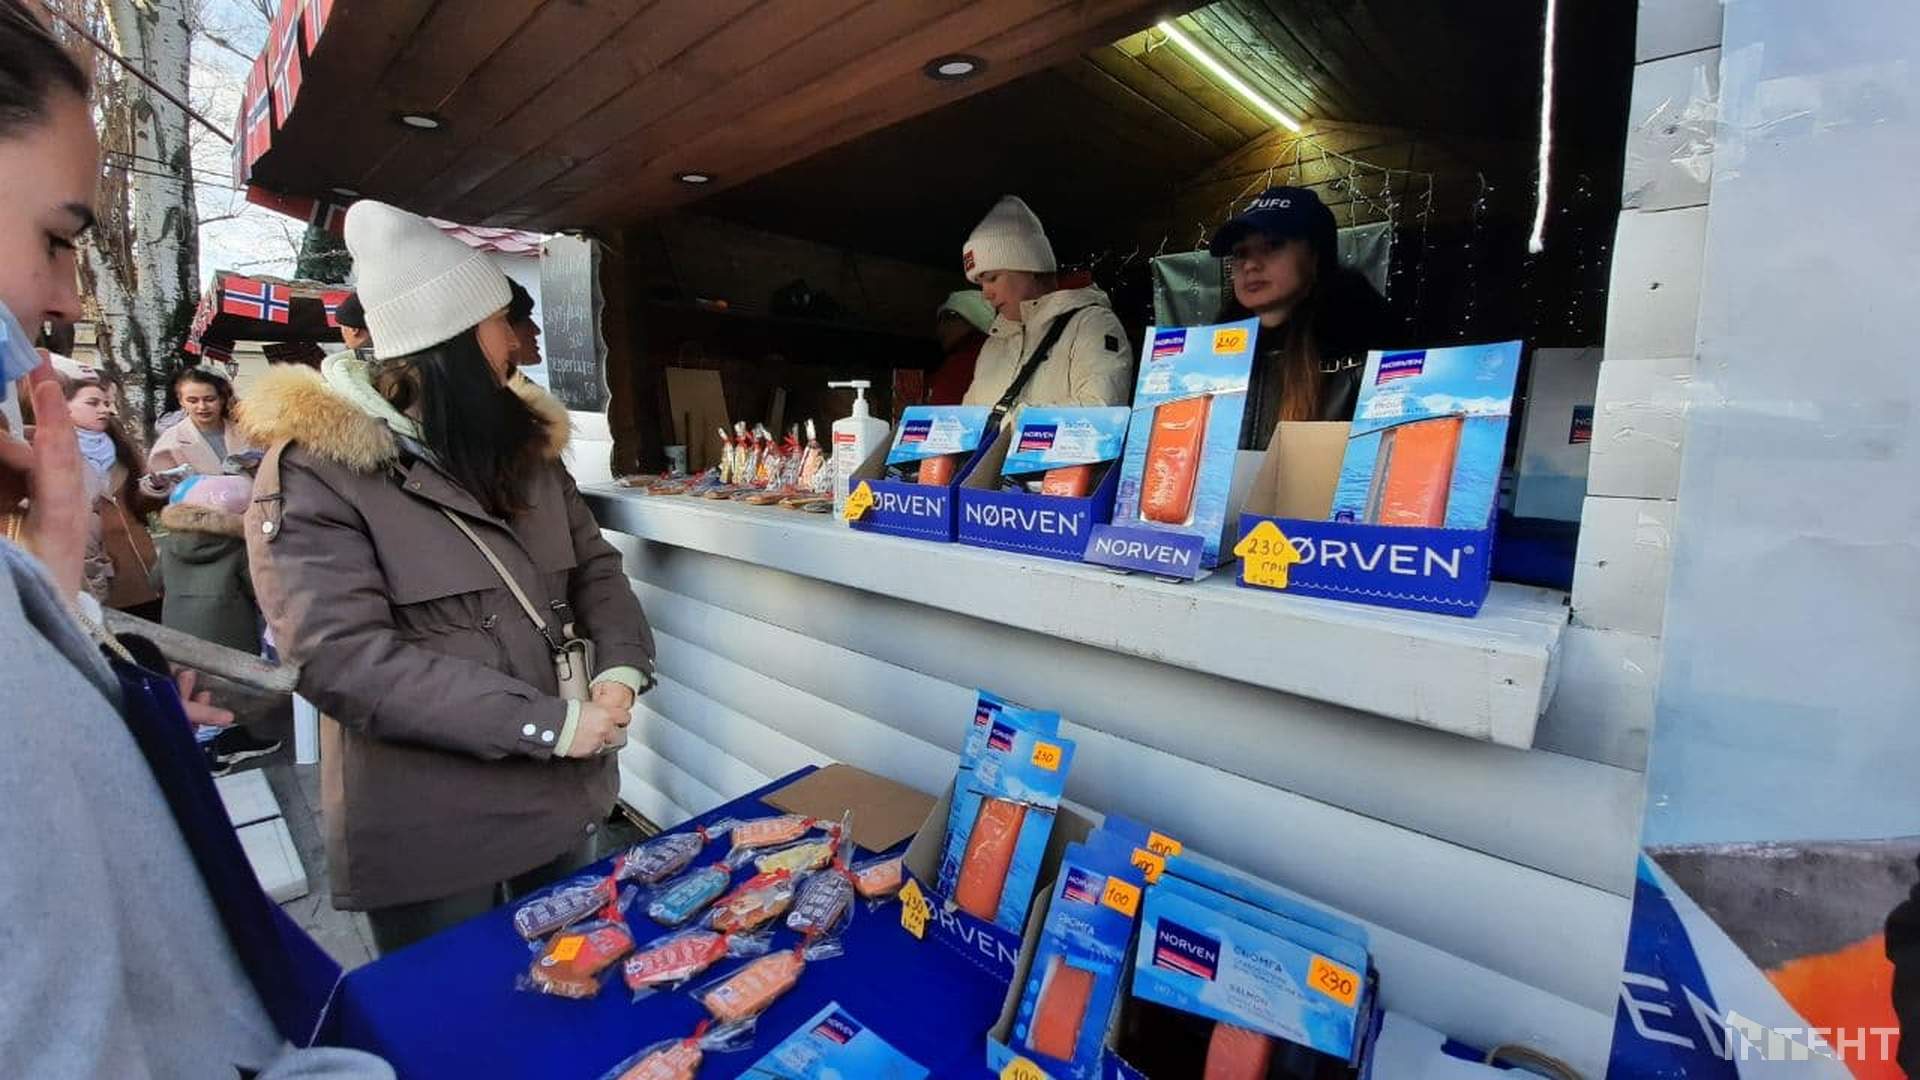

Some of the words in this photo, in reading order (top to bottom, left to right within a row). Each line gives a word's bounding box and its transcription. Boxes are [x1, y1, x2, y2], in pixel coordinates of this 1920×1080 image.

[1258, 199, 1291, 209] UFC
[1095, 538, 1191, 566] NORVEN
[1247, 538, 1285, 556] 230
[1289, 537, 1460, 579] ØRVEN
[1107, 887, 1129, 906] 100
[1159, 930, 1217, 964] NORVEN
[1320, 967, 1352, 996] 230
